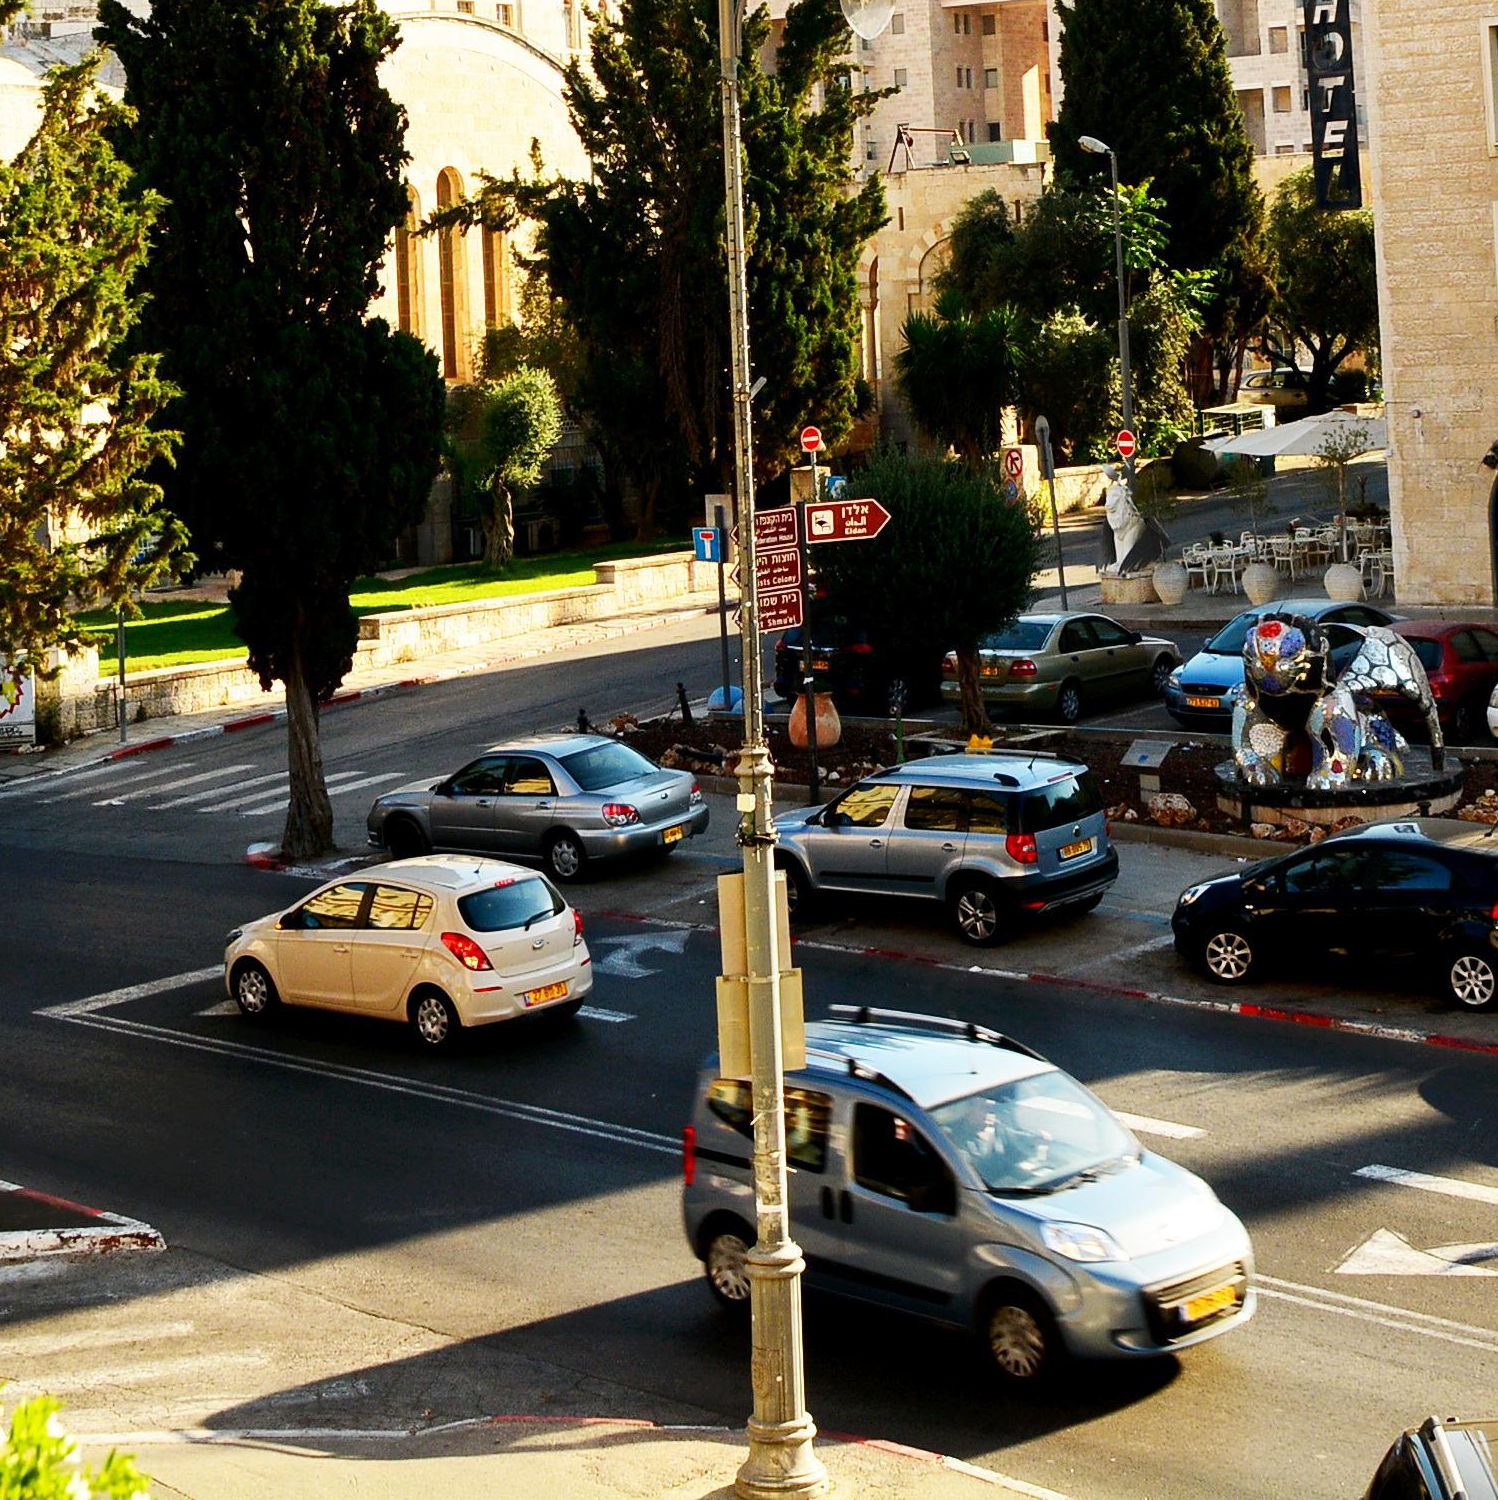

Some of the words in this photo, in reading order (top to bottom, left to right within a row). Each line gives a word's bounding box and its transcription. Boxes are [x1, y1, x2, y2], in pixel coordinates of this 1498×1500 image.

[841, 504, 869, 519] אלדן
[844, 527, 867, 535] Eldan
[771, 552, 796, 565] חוצות
[757, 578, 771, 588] ists
[772, 575, 797, 585] Colony
[759, 596, 778, 608] שמו
[781, 592, 798, 605] בית
